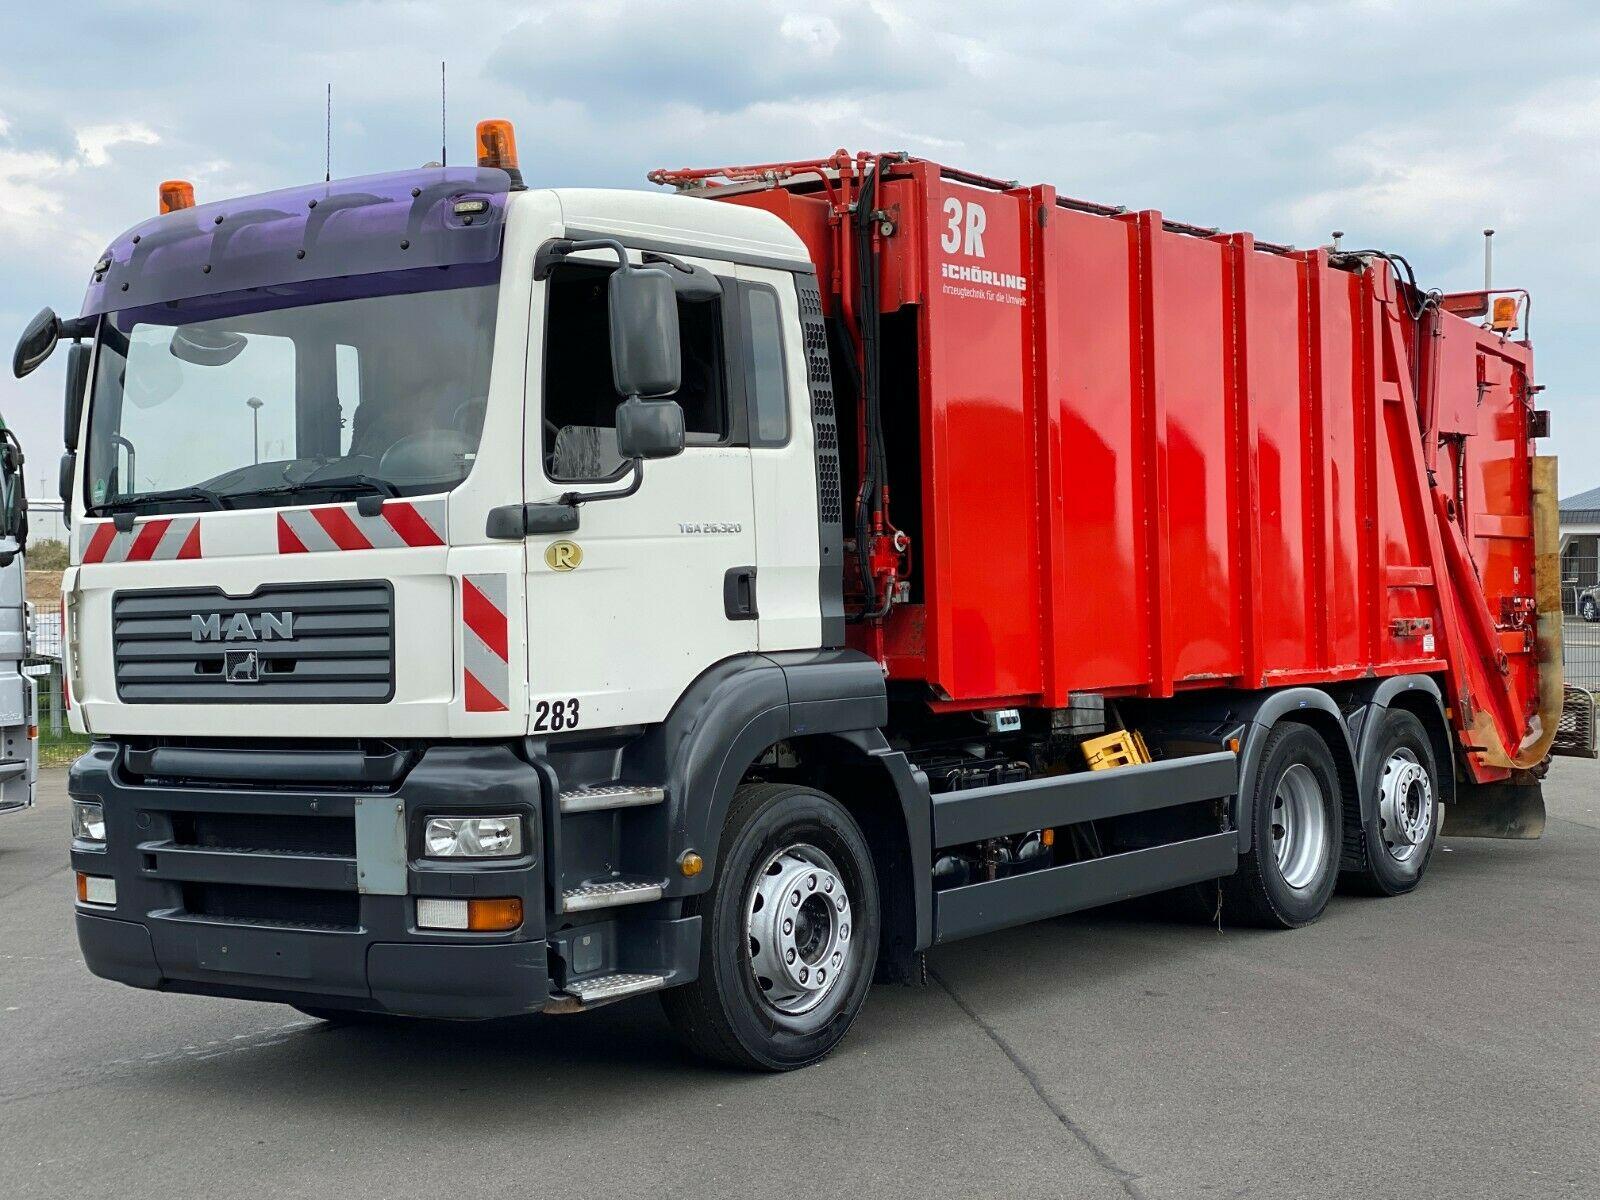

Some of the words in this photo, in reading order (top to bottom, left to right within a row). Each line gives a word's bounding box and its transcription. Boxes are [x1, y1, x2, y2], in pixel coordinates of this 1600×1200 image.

[941, 197, 987, 258] 3R
[986, 290, 995, 301] für
[996, 292, 1005, 303] die
[679, 523, 701, 534] TGA
[703, 522, 742, 534] 26.320
[553, 543, 577, 569] R
[191, 611, 294, 641] MAN
[533, 698, 580, 731] 283
